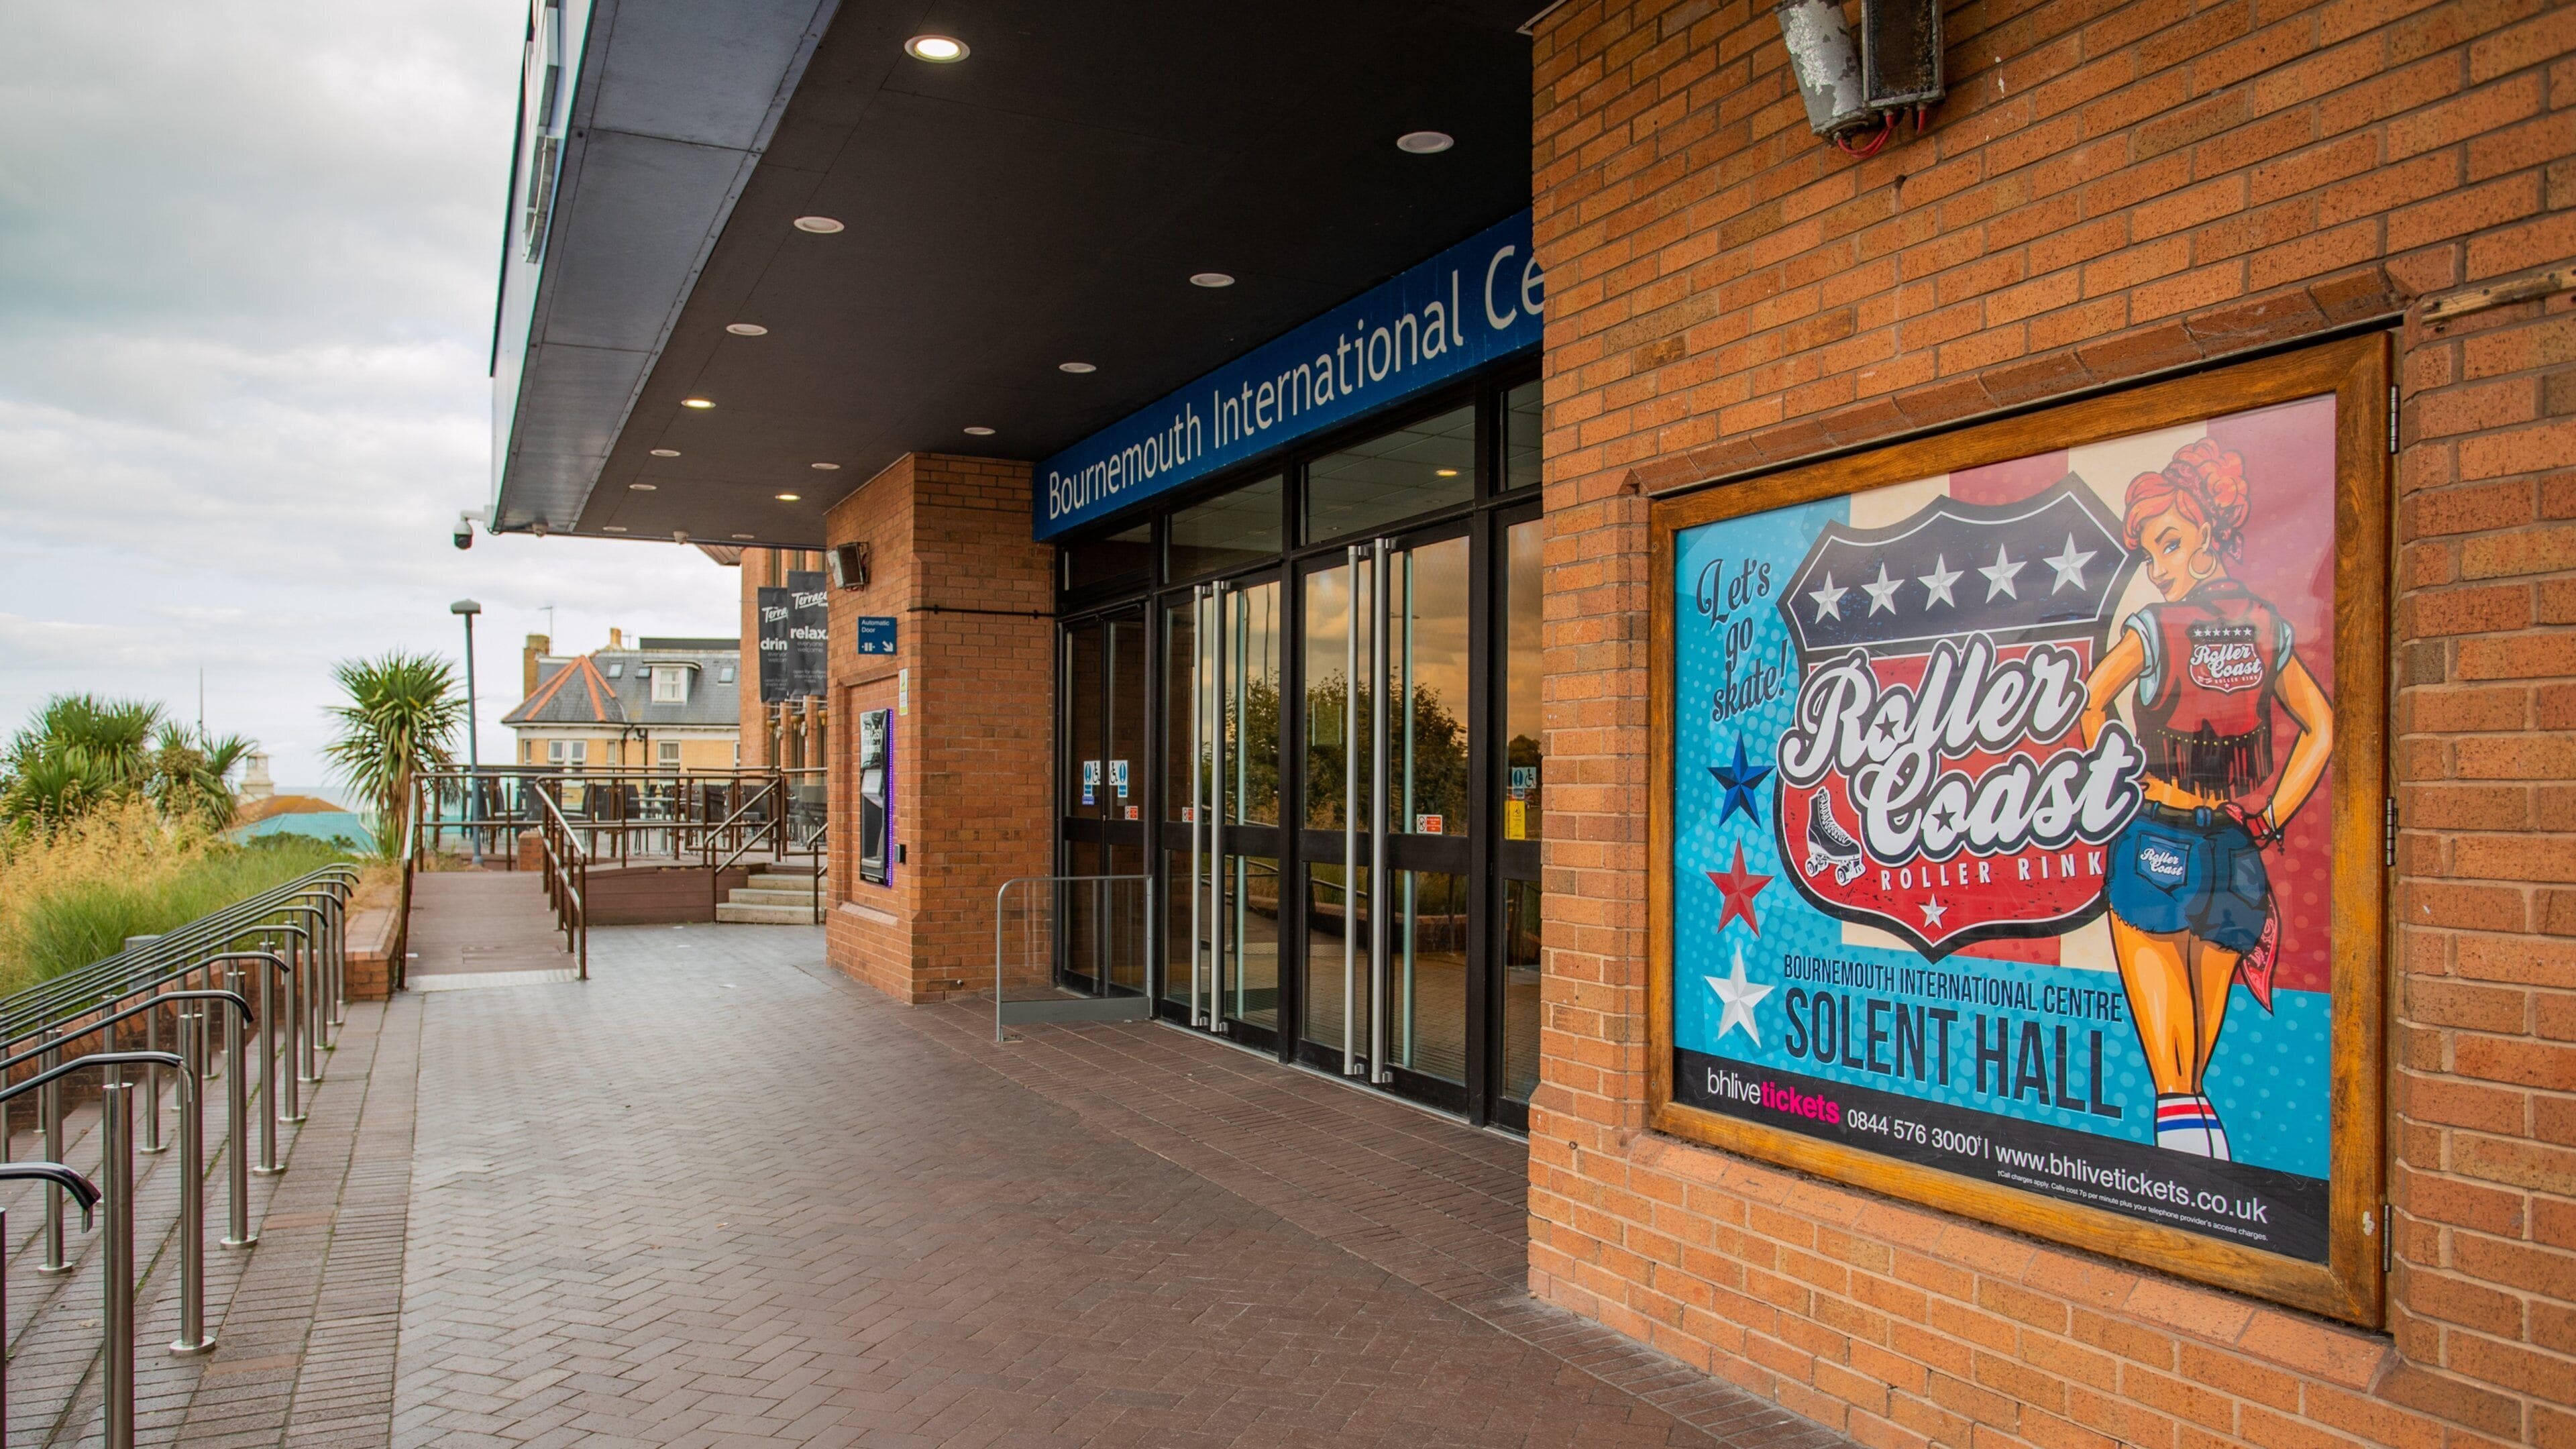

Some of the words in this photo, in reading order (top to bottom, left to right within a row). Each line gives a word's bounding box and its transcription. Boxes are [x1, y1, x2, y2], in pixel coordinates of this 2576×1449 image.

[1049, 403, 1201, 520] Bournemouth
[1214, 270, 1464, 449] International
[1485, 245, 1544, 330] Ce
[1697, 557, 1771, 630] Let's
[1725, 616, 1754, 672] go
[2190, 643, 2251, 665] Roller
[2208, 657, 2261, 678] Coast
[1712, 639, 1788, 722] skate!
[1782, 641, 2078, 769] Roller
[1854, 731, 2135, 856] Coast
[1880, 861, 1990, 891] ROLLER
[2019, 852, 2102, 881] RINK
[2140, 848, 2180, 865] Roller
[2150, 859, 2183, 875] Coast
[1784, 954, 1895, 993] BOURNEMOUTH
[1900, 967, 2038, 1012] INTERNATIONAL
[2043, 984, 2123, 1023] CENTRE
[1784, 987, 1958, 1087] SOLENT
[1976, 1014, 2123, 1120] HALL
[1707, 1067, 1840, 1124] bhlivetickets
[1847, 1109, 1889, 1135] 0844
[1894, 1120, 1926, 1144] 576
[1996, 1145, 2267, 1224] www.bhlivetickets.co.uk
[2011, 1174, 2033, 1184] charges
[2034, 1179, 2050, 1188] apply.
[2051, 1183, 2065, 1192] Calls
[2080, 1189, 2087, 1197] 7p
[2099, 1195, 2118, 1204] minute
[2119, 1199, 2133, 1208] plus
[2133, 1203, 2147, 1212] your
[2148, 1206, 2179, 1220] telephone
[2180, 1215, 2212, 1227] provider's
[2213, 1223, 2237, 1234] access
[2238, 1229, 2268, 1240] charges.
